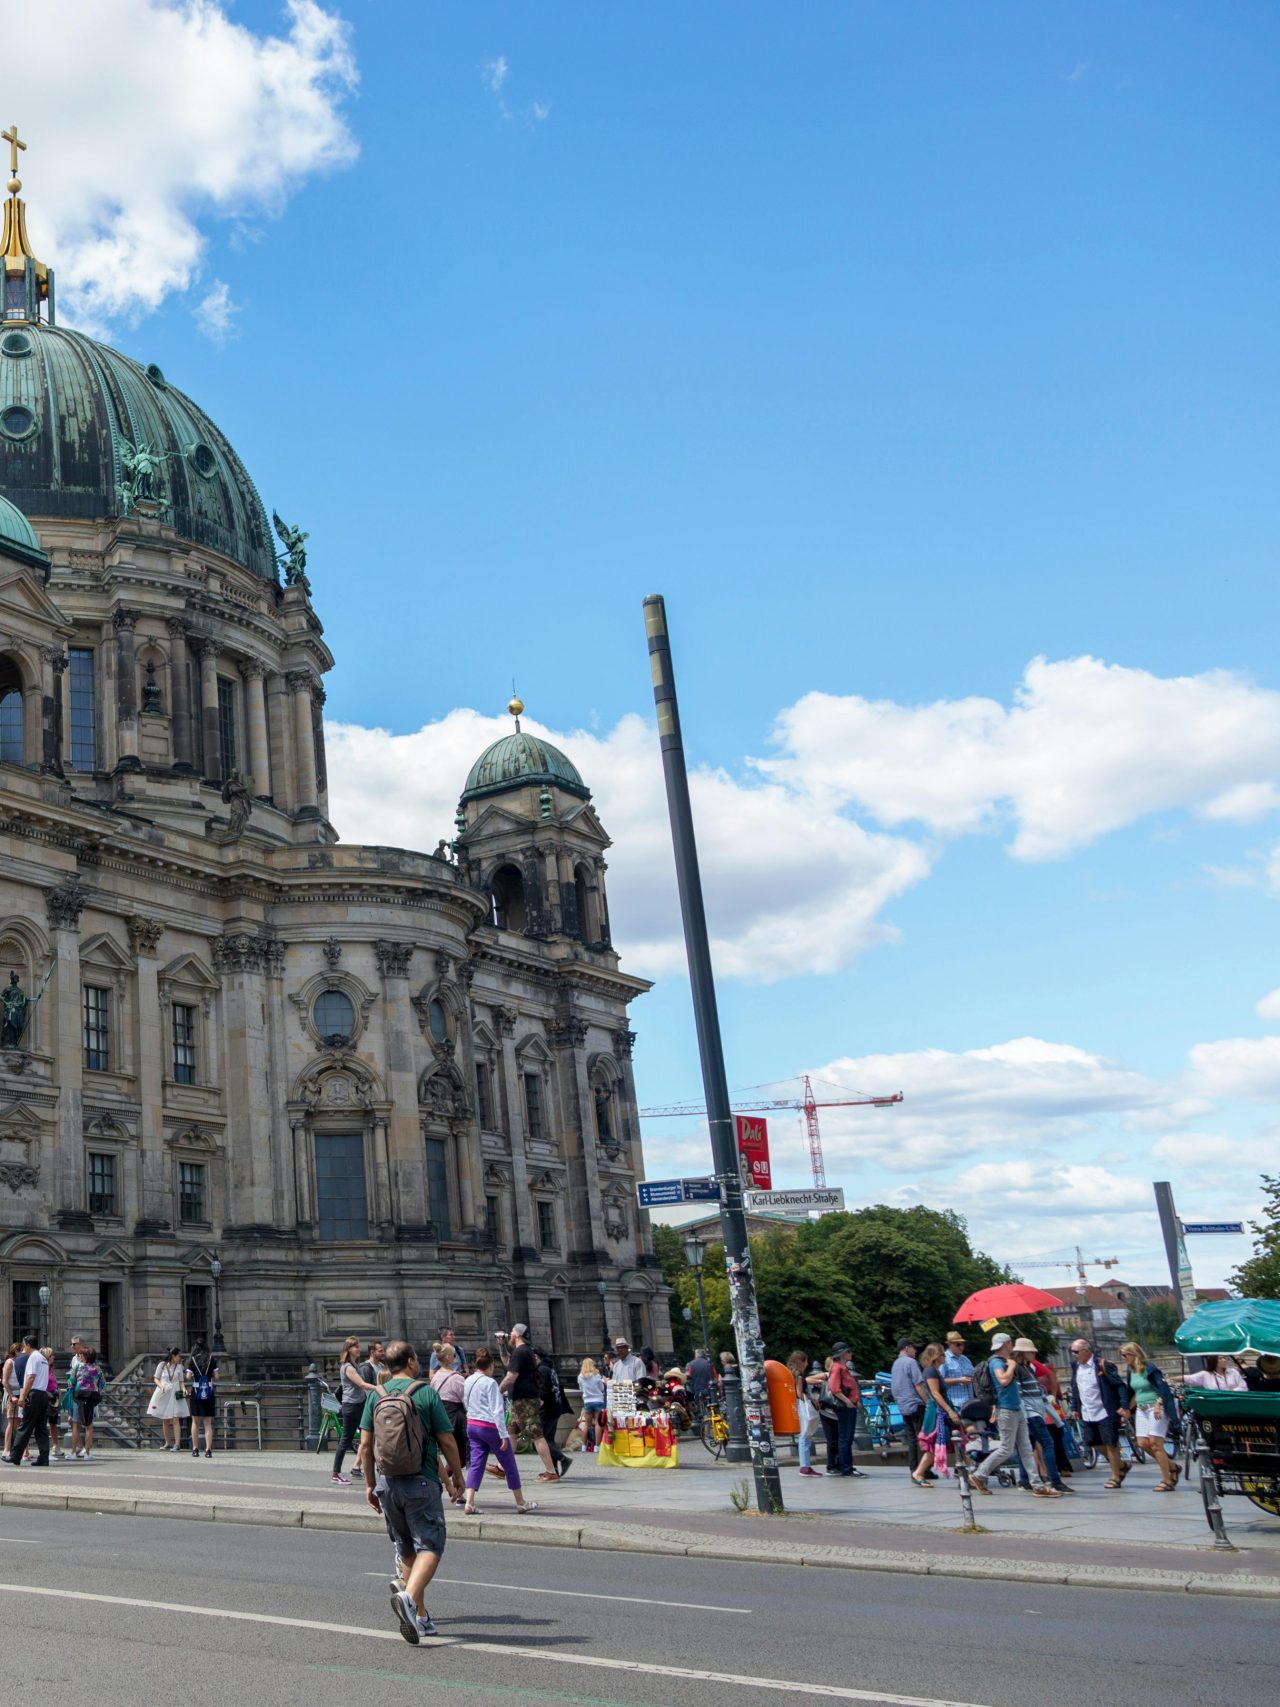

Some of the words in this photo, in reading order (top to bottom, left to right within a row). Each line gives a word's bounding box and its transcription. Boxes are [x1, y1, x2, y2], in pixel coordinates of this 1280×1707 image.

[754, 1161, 760, 1173] S
[761, 1161, 768, 1173] U
[752, 1192, 839, 1206] Karl-Liebknecht-Straße
